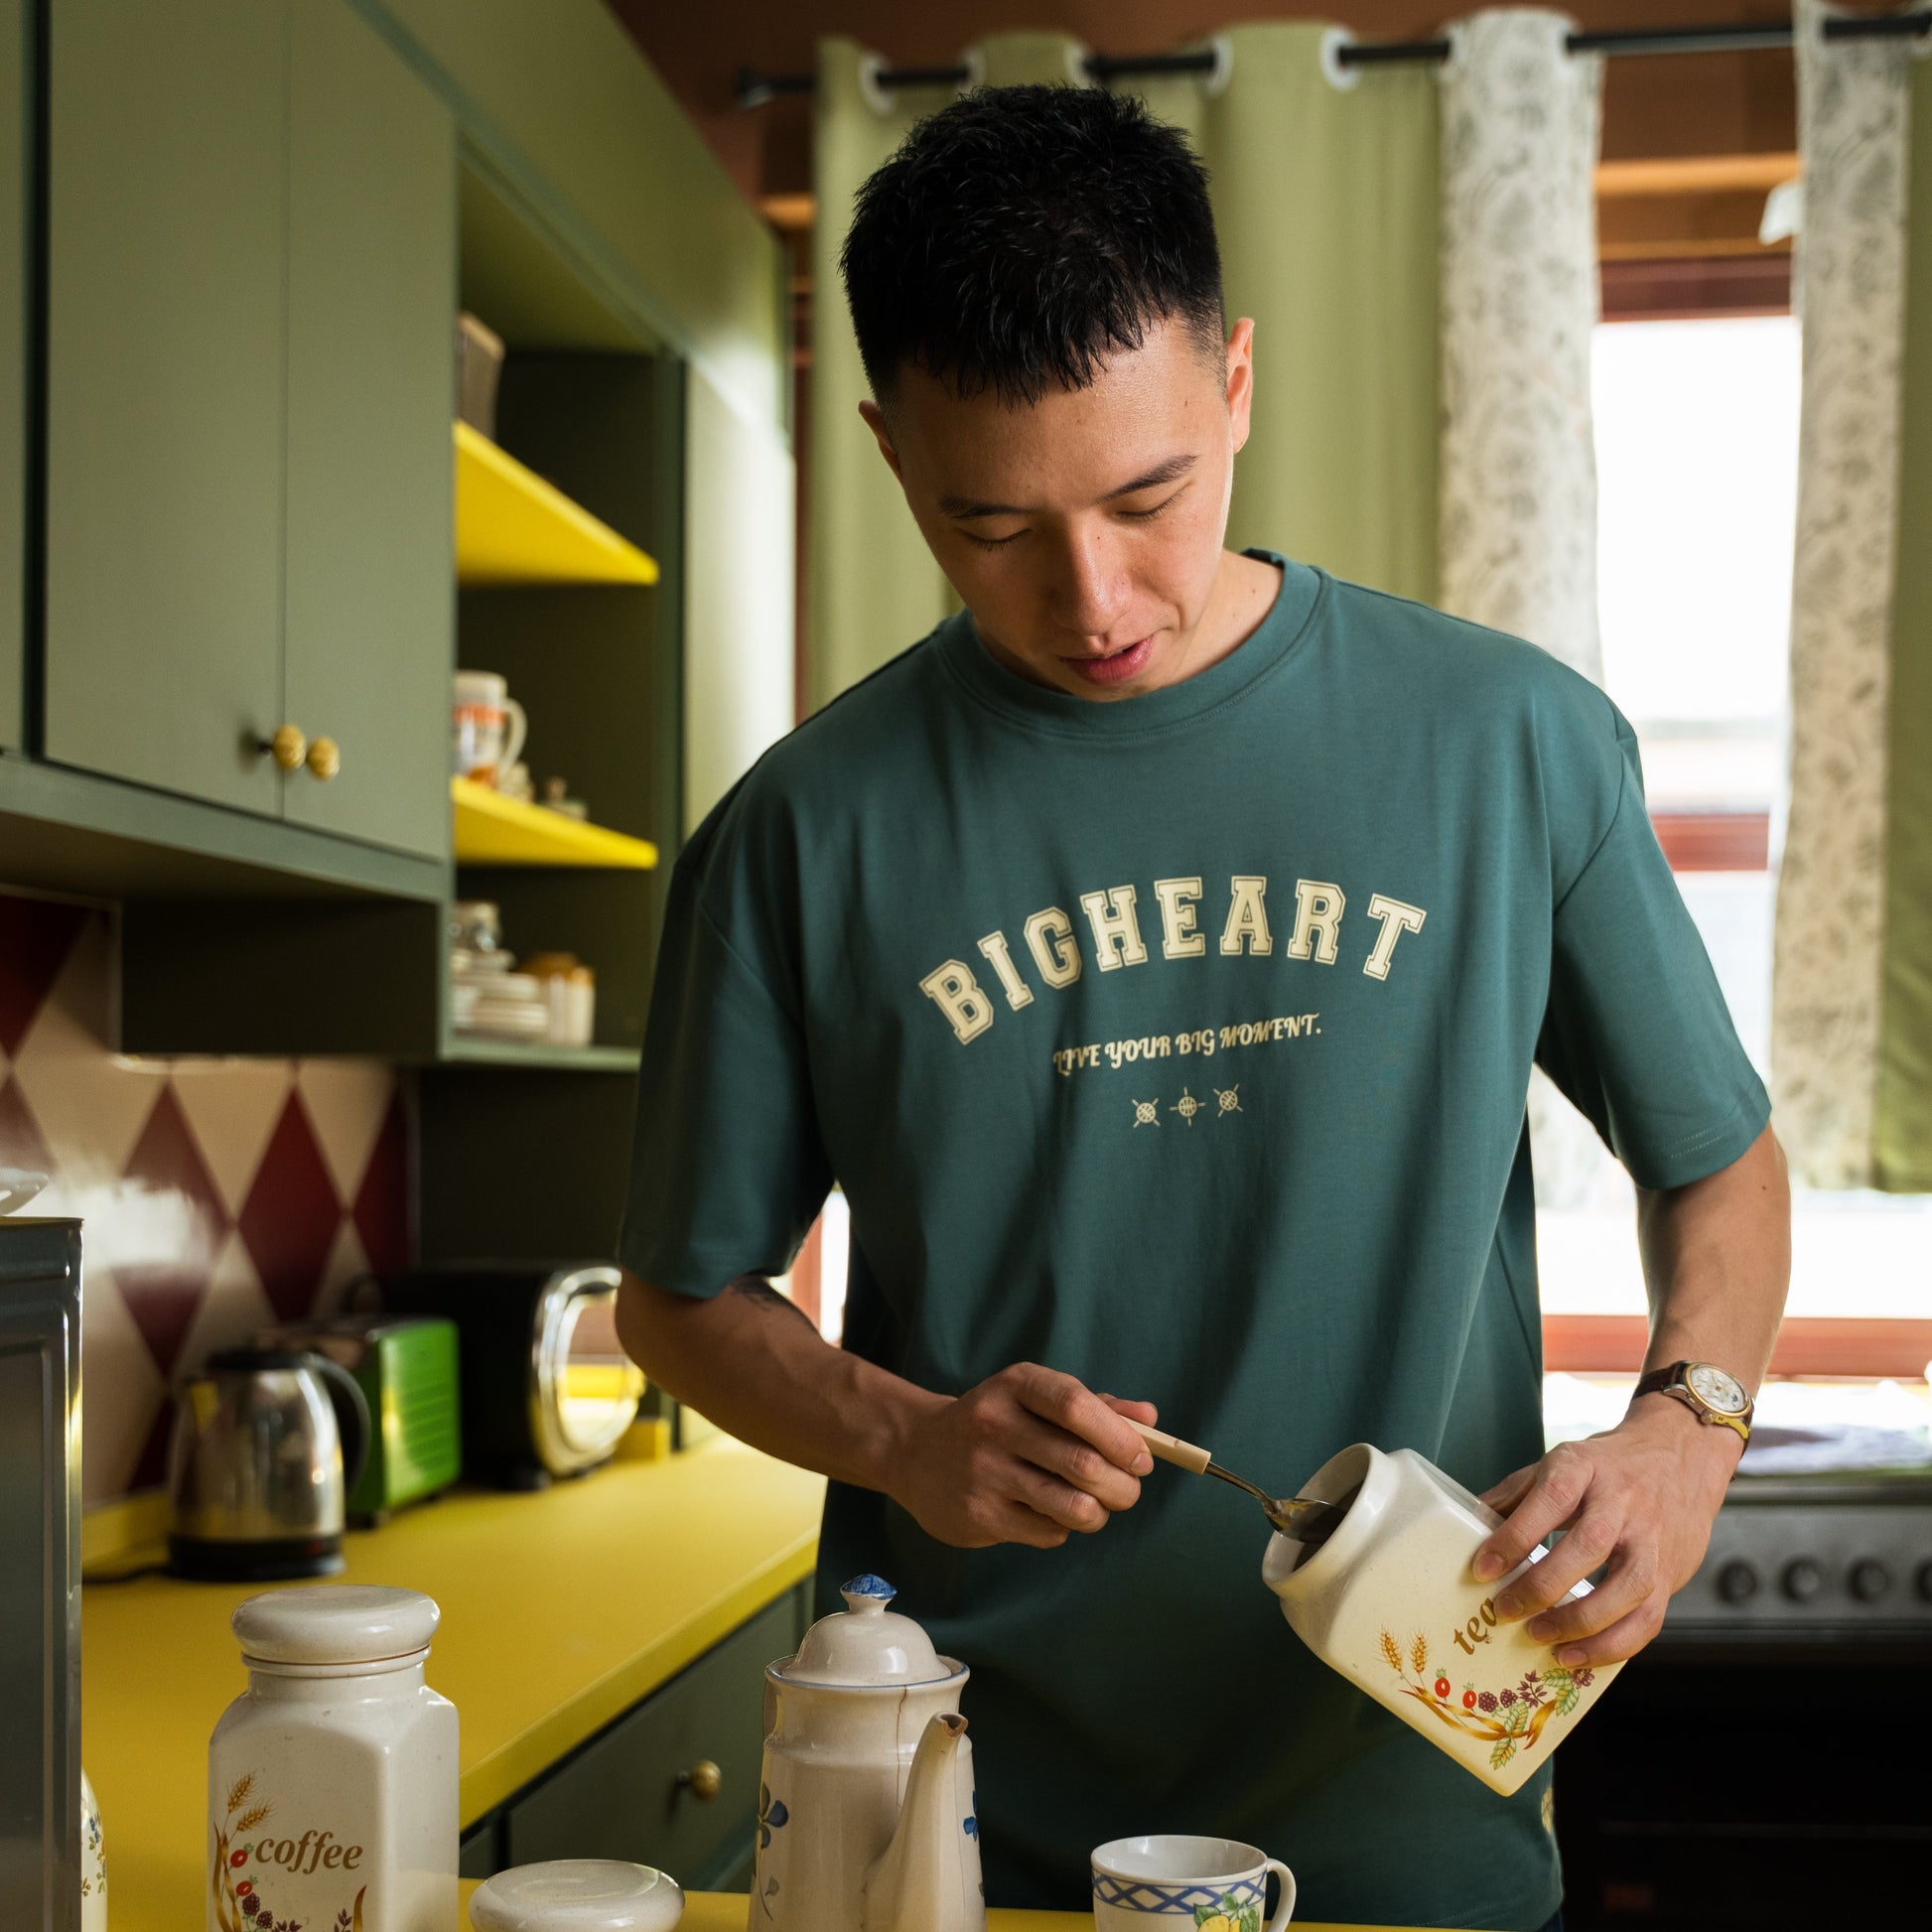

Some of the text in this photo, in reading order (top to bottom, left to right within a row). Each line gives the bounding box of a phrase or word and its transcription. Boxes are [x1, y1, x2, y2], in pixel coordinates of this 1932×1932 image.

[918, 876, 1427, 1045] BIGHEART
[1052, 1013, 1322, 1077] LIVE YOUR BIG MOMENT.
[1453, 1597, 1497, 1656] tea
[255, 1829, 363, 1874] coffee
